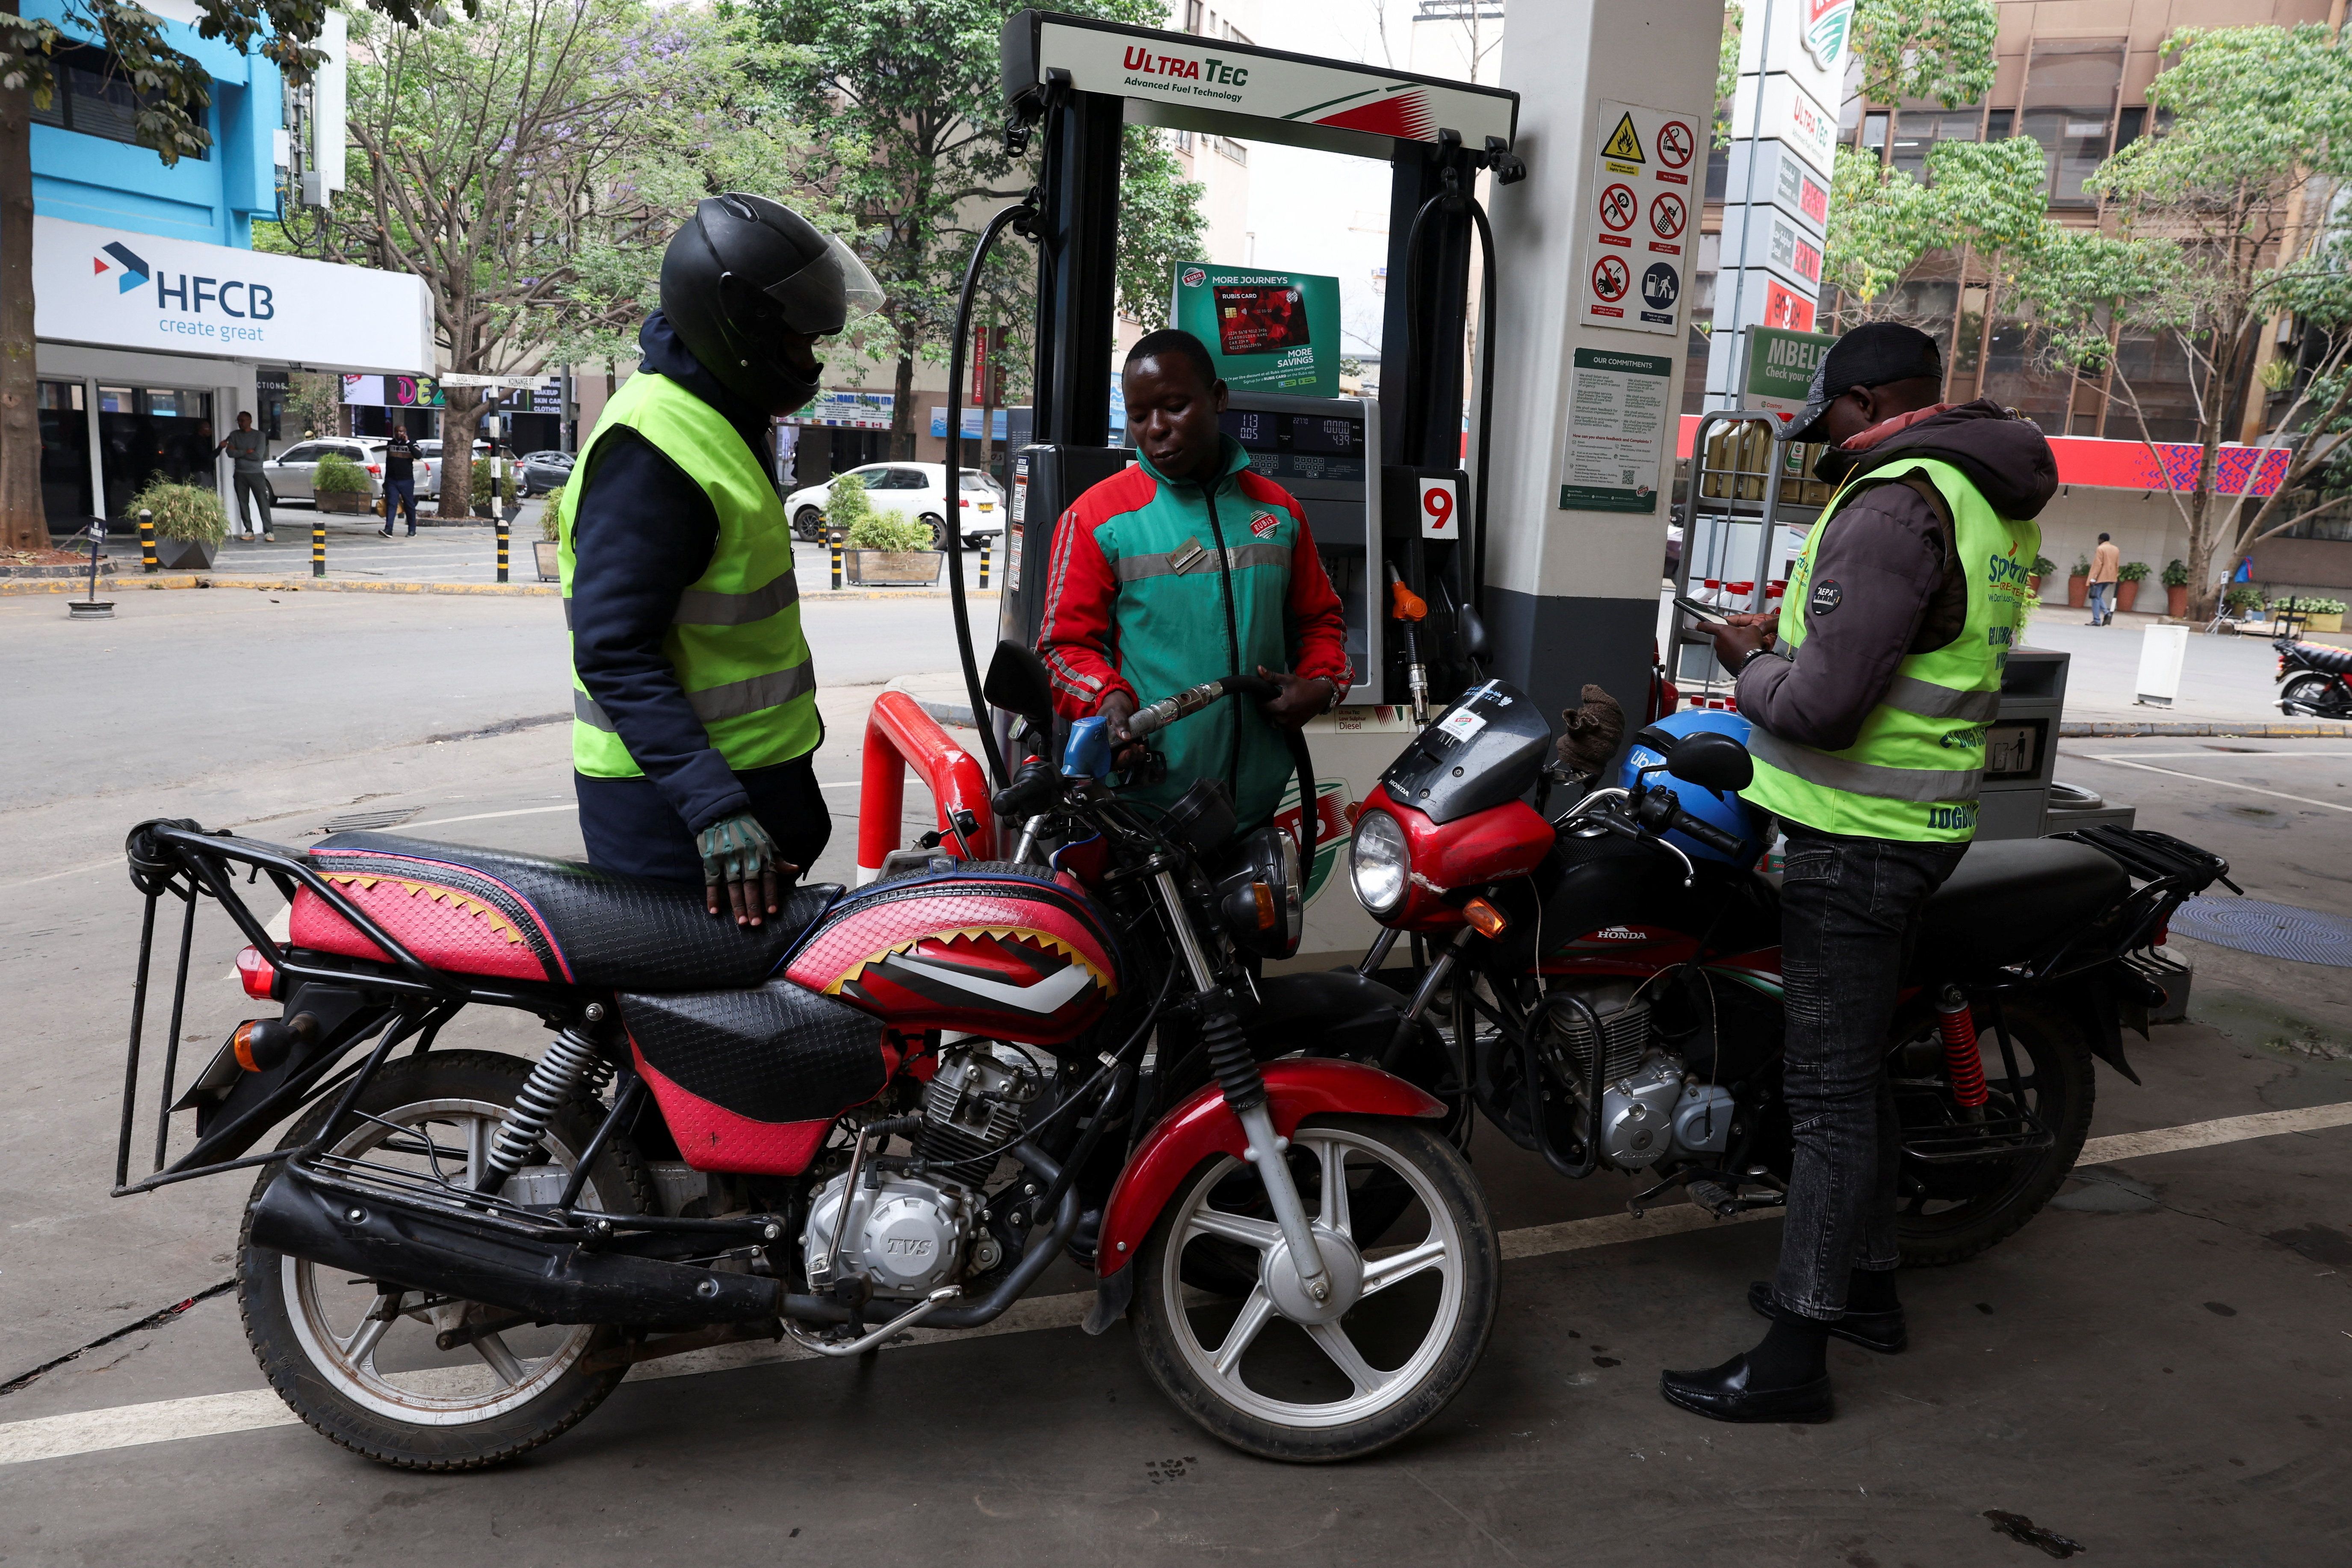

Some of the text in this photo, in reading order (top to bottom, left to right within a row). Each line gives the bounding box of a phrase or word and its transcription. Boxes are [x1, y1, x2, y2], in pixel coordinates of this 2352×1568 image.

[1123, 46, 1248, 86] ULTRA TEC
[1124, 77, 1242, 103] Advanced Fuel Technology
[1794, 95, 1828, 148] ULTRA TEC
[157, 271, 274, 320] HFCB
[160, 320, 264, 342] create great
[1277, 355, 1314, 367] SAVINGS
[1288, 348, 1312, 358] MORE
[1608, 358, 1652, 369] COMMITMENTS
[1766, 366, 1787, 379] Check
[1788, 372, 1805, 382] your
[1423, 487, 1453, 529] 9
[1389, 779, 1409, 797] HONDA
[887, 1238, 933, 1256] TVS
